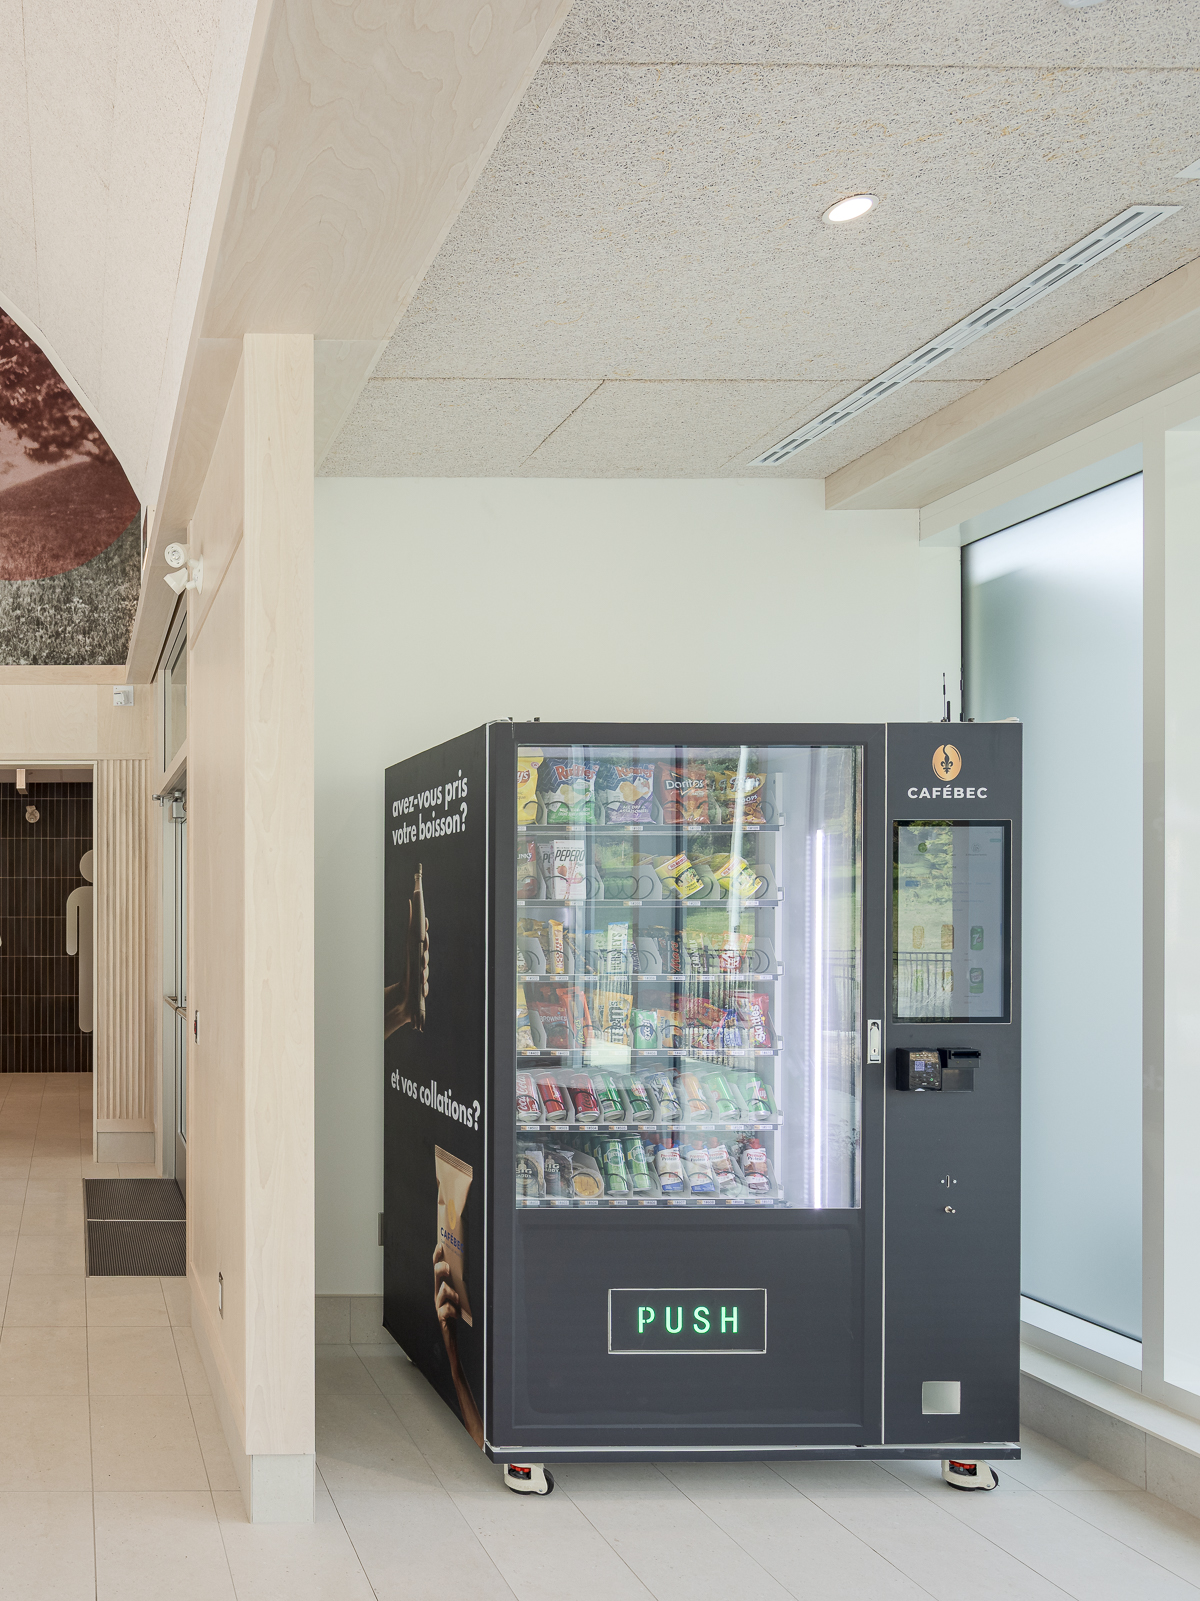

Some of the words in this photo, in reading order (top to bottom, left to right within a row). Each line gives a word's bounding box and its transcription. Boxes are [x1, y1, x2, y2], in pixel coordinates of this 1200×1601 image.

[517, 770, 530, 783] y's
[666, 779, 704, 789] Doritos
[392, 786, 442, 818] avez-vous
[445, 770, 468, 810] pris
[908, 785, 988, 799] CAFÉBEC
[392, 822, 417, 845] votre
[419, 802, 468, 840] boisson?
[555, 850, 585, 861] PEPERO
[612, 932, 622, 972] HERSHEY'S
[671, 941, 680, 972] Mars
[391, 1069, 400, 1091] et
[401, 1077, 418, 1100] vos
[420, 1080, 480, 1131] collations?
[638, 1306, 738, 1334] PUSH
